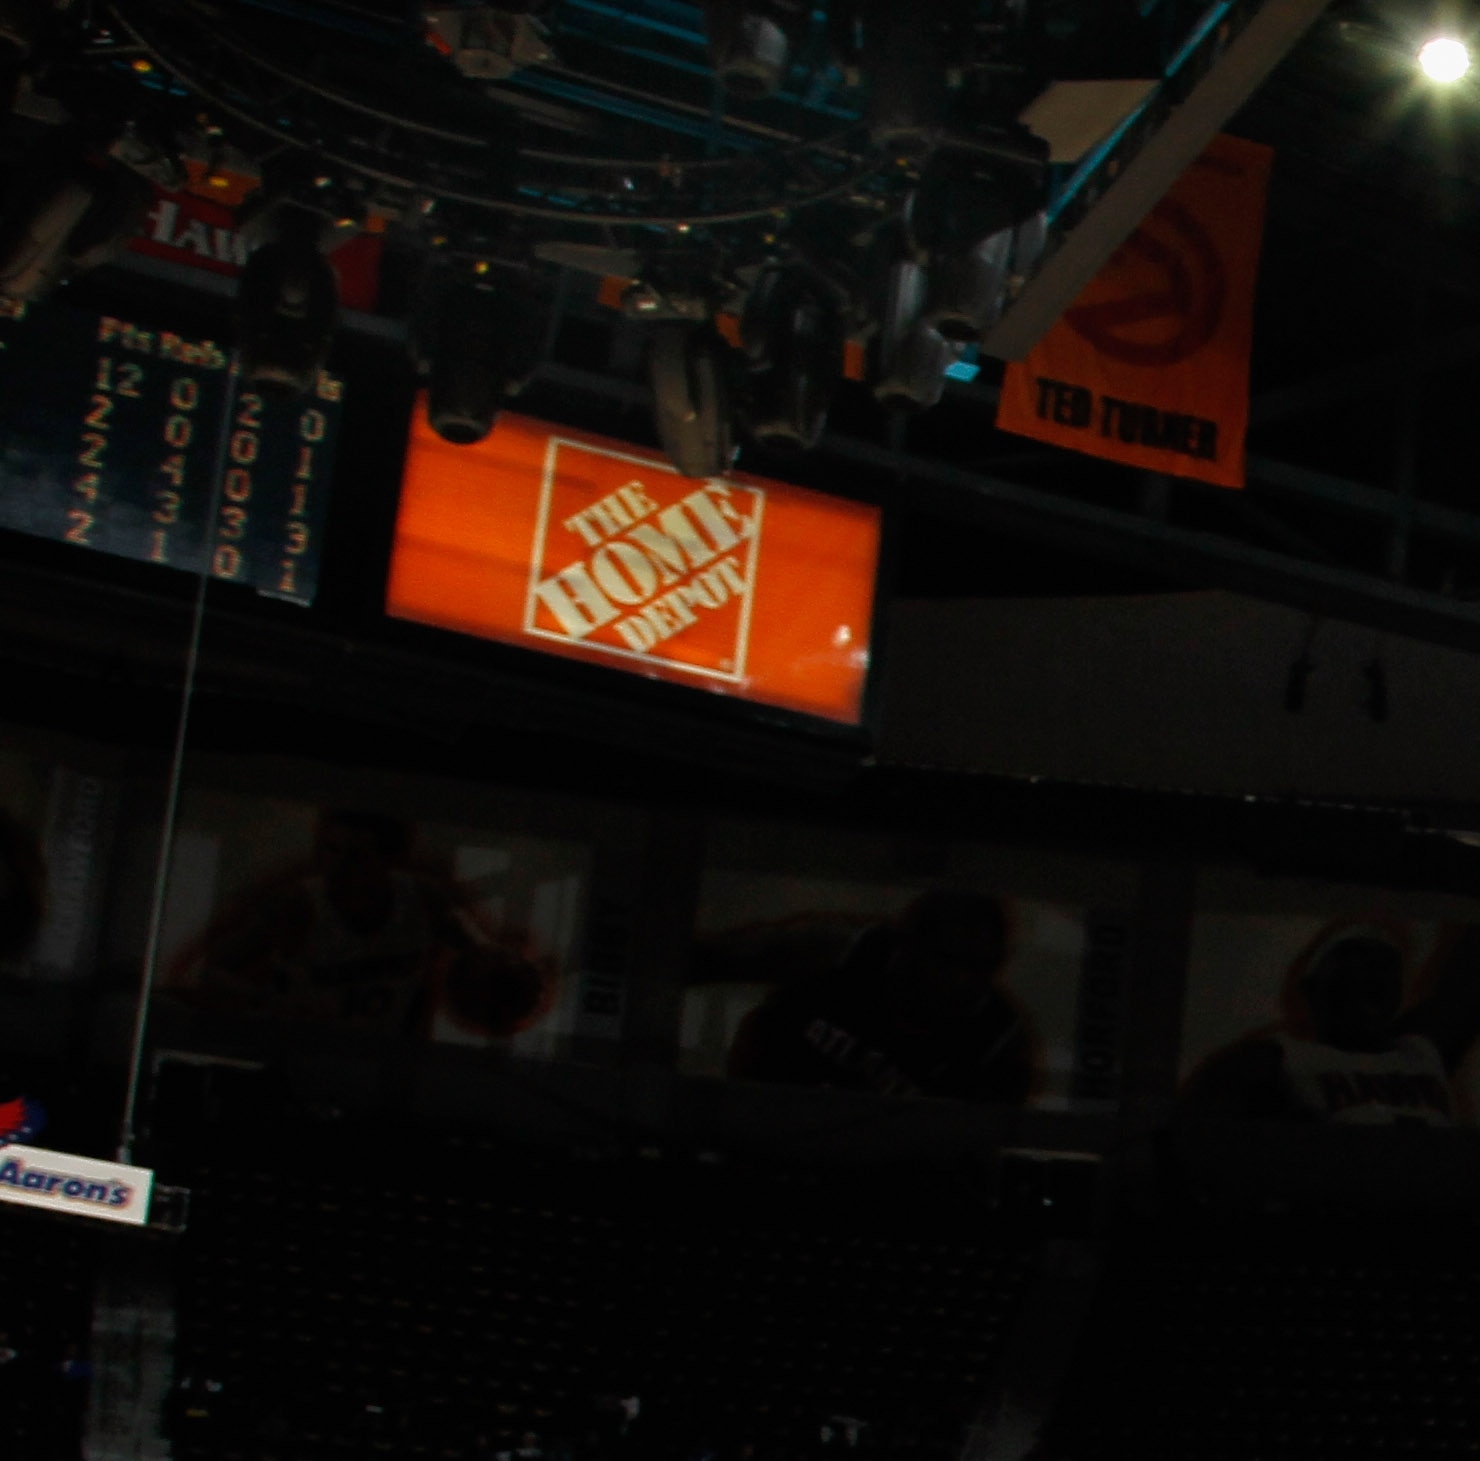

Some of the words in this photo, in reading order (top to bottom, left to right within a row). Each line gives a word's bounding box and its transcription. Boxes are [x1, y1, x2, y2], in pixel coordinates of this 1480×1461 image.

[84, 394, 114, 430] 2
[163, 415, 193, 449] 0
[229, 431, 260, 466] 0
[96, 357, 144, 398] 12
[170, 377, 199, 411] 0
[236, 393, 263, 429] 2
[300, 408, 327, 442] 0
[1036, 377, 1092, 429] TED
[1101, 395, 1217, 463] TURNER
[79, 432, 108, 469] 2
[224, 467, 252, 502] 0
[63, 509, 96, 545] 2
[212, 543, 241, 579] 0
[152, 493, 181, 525] 3
[218, 505, 248, 541] 3
[282, 520, 311, 556] 3
[562, 479, 660, 547] THE
[533, 477, 758, 641] HOME
[612, 554, 750, 653] DEPOT
[0, 1158, 130, 1207] Aaron's
